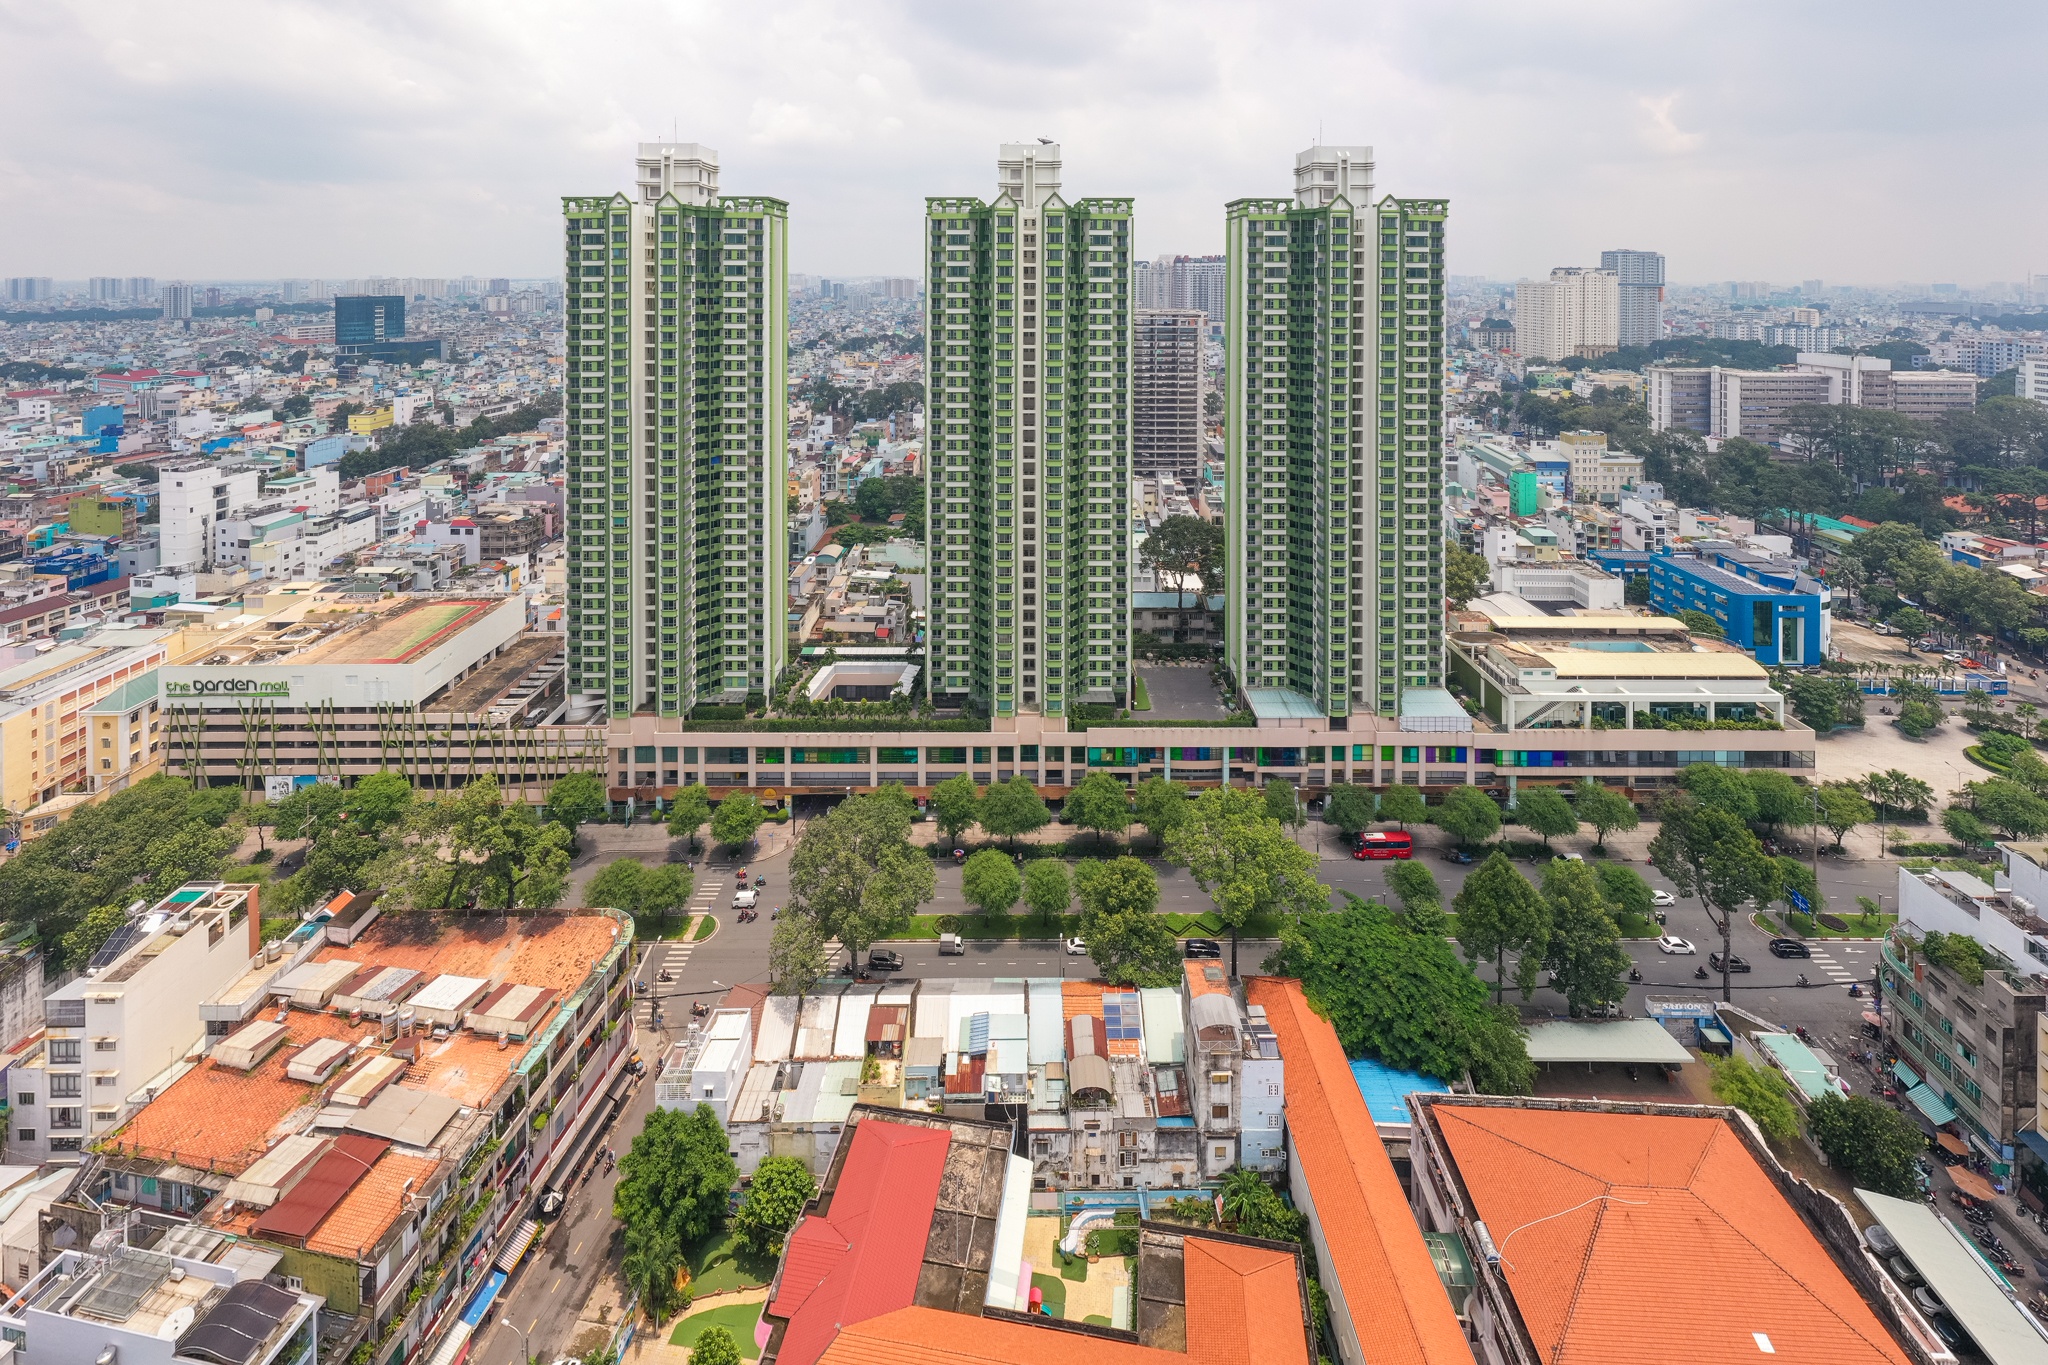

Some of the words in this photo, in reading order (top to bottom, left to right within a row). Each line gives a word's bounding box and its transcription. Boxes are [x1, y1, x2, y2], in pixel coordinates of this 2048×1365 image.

[166, 681, 190, 692] the
[193, 678, 257, 695] garden
[260, 681, 289, 692] mall
